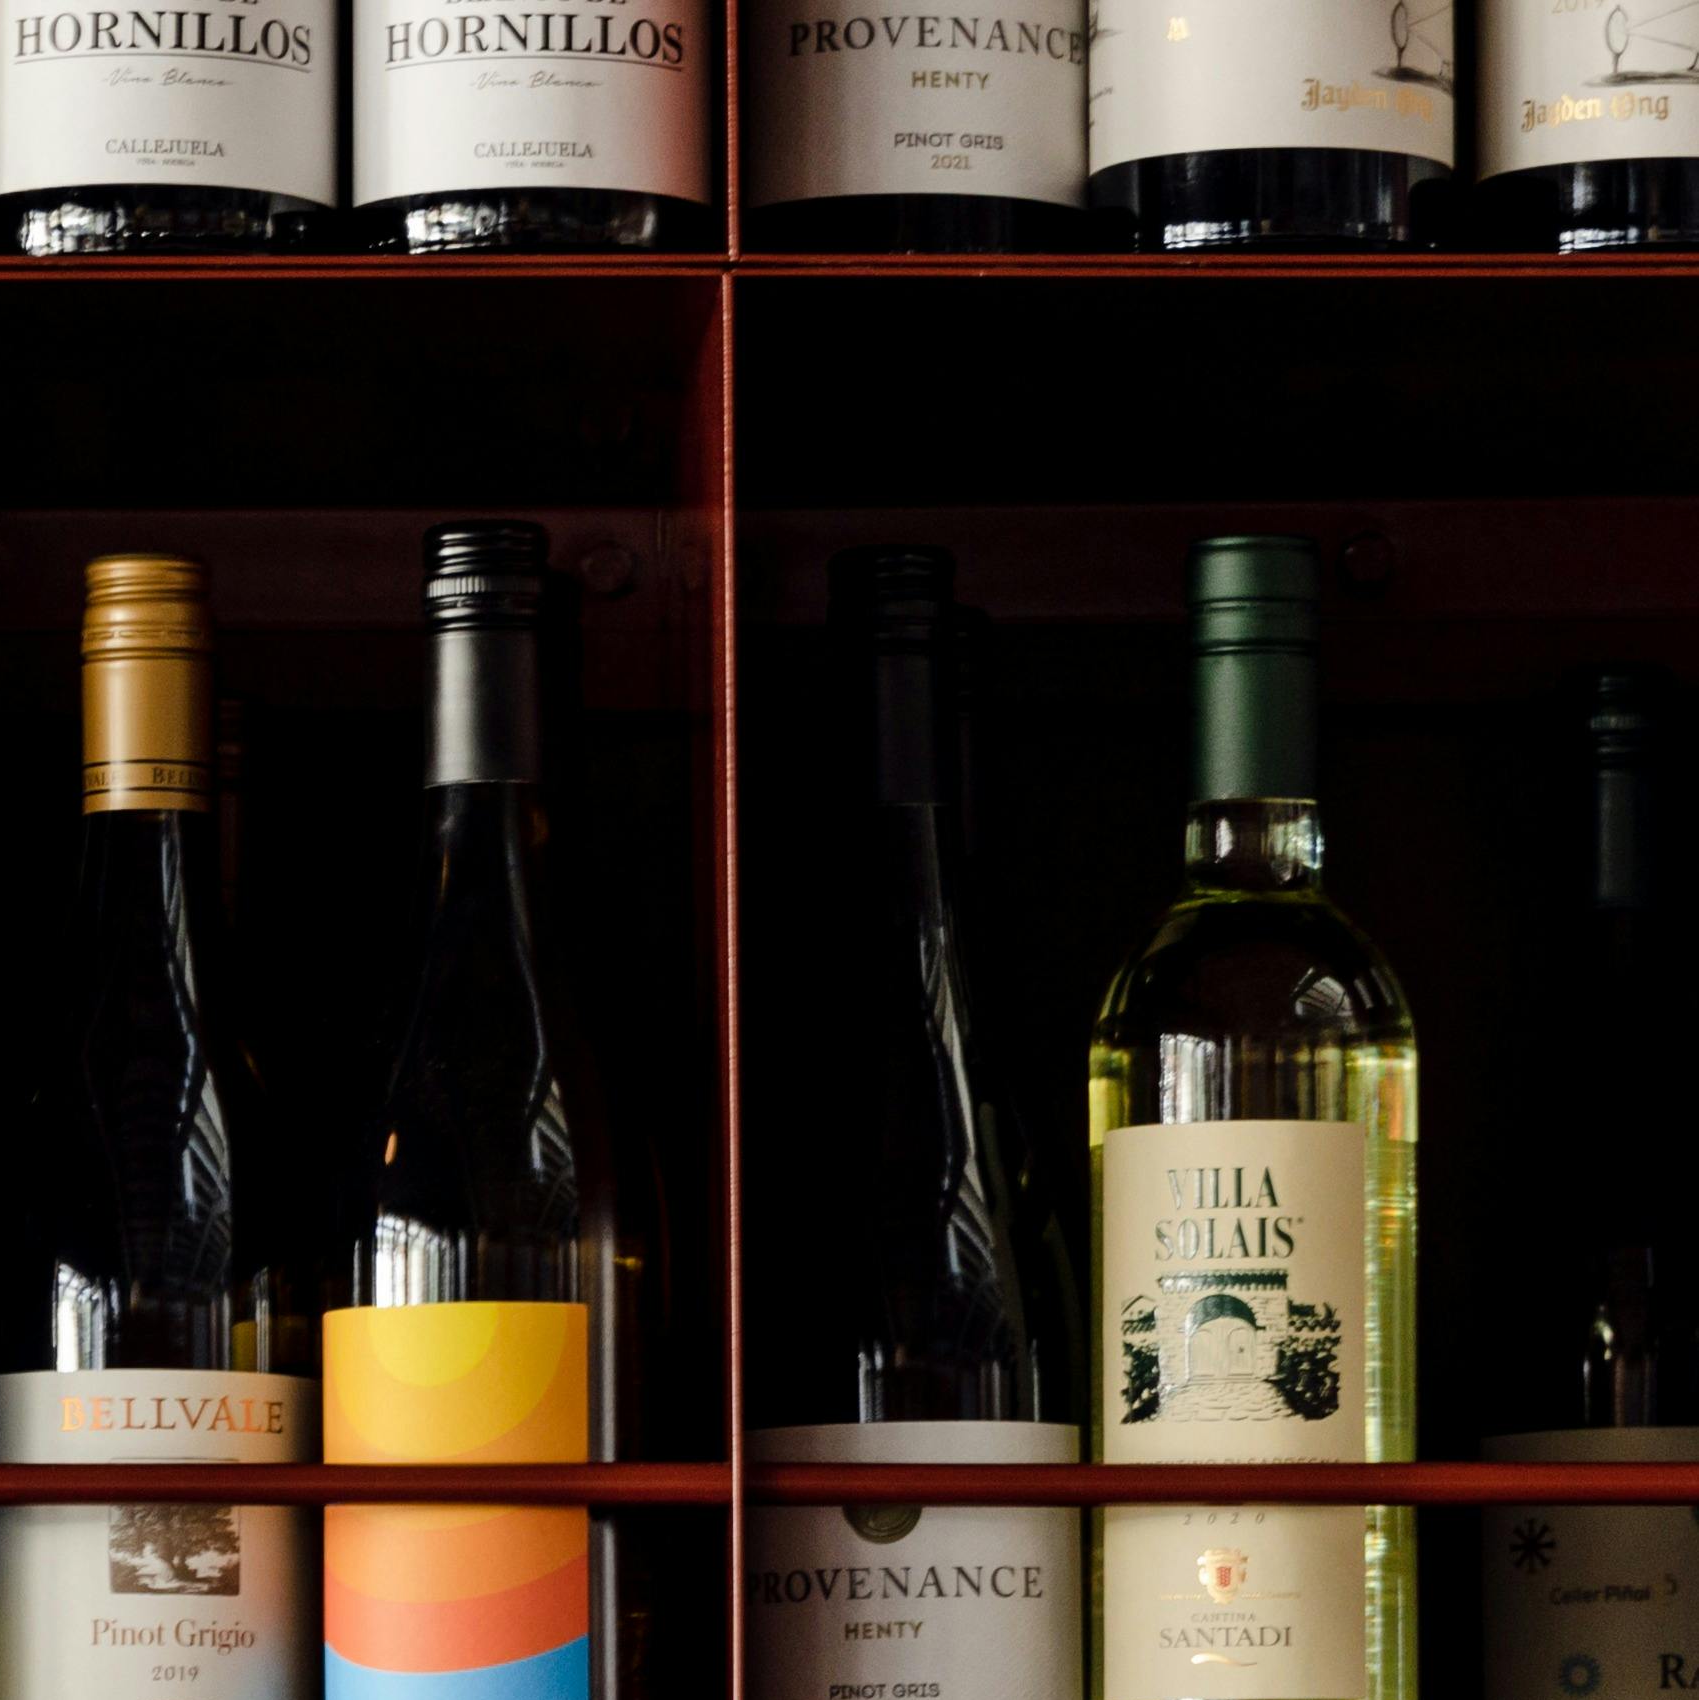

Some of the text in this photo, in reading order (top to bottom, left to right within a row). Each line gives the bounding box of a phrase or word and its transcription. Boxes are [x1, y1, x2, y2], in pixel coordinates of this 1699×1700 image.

[14, 11, 312, 66] HORNILLOS
[384, 13, 684, 65] HORNILLOS
[789, 16, 1084, 66] PROVENANCE
[911, 71, 990, 90] HENTY
[1521, 91, 1669, 133] Jayden Ong
[105, 138, 225, 157] CALLEJUELA
[473, 142, 594, 159] CALLEJUELA
[894, 132, 1004, 150] PINOT GRIS
[931, 155, 971, 170] 2021
[1167, 1166, 1281, 1210] VILLA
[59, 1395, 284, 1434] BELLVALE
[1190, 1612, 1258, 1624] CANTINA
[90, 1617, 255, 1656] Pinot Grigio
[844, 1621, 923, 1640] HENTY
[1158, 1626, 1293, 1649] SANTADI
[152, 1664, 200, 1682] 2019
[830, 1683, 940, 1700] PINOT GRIS
